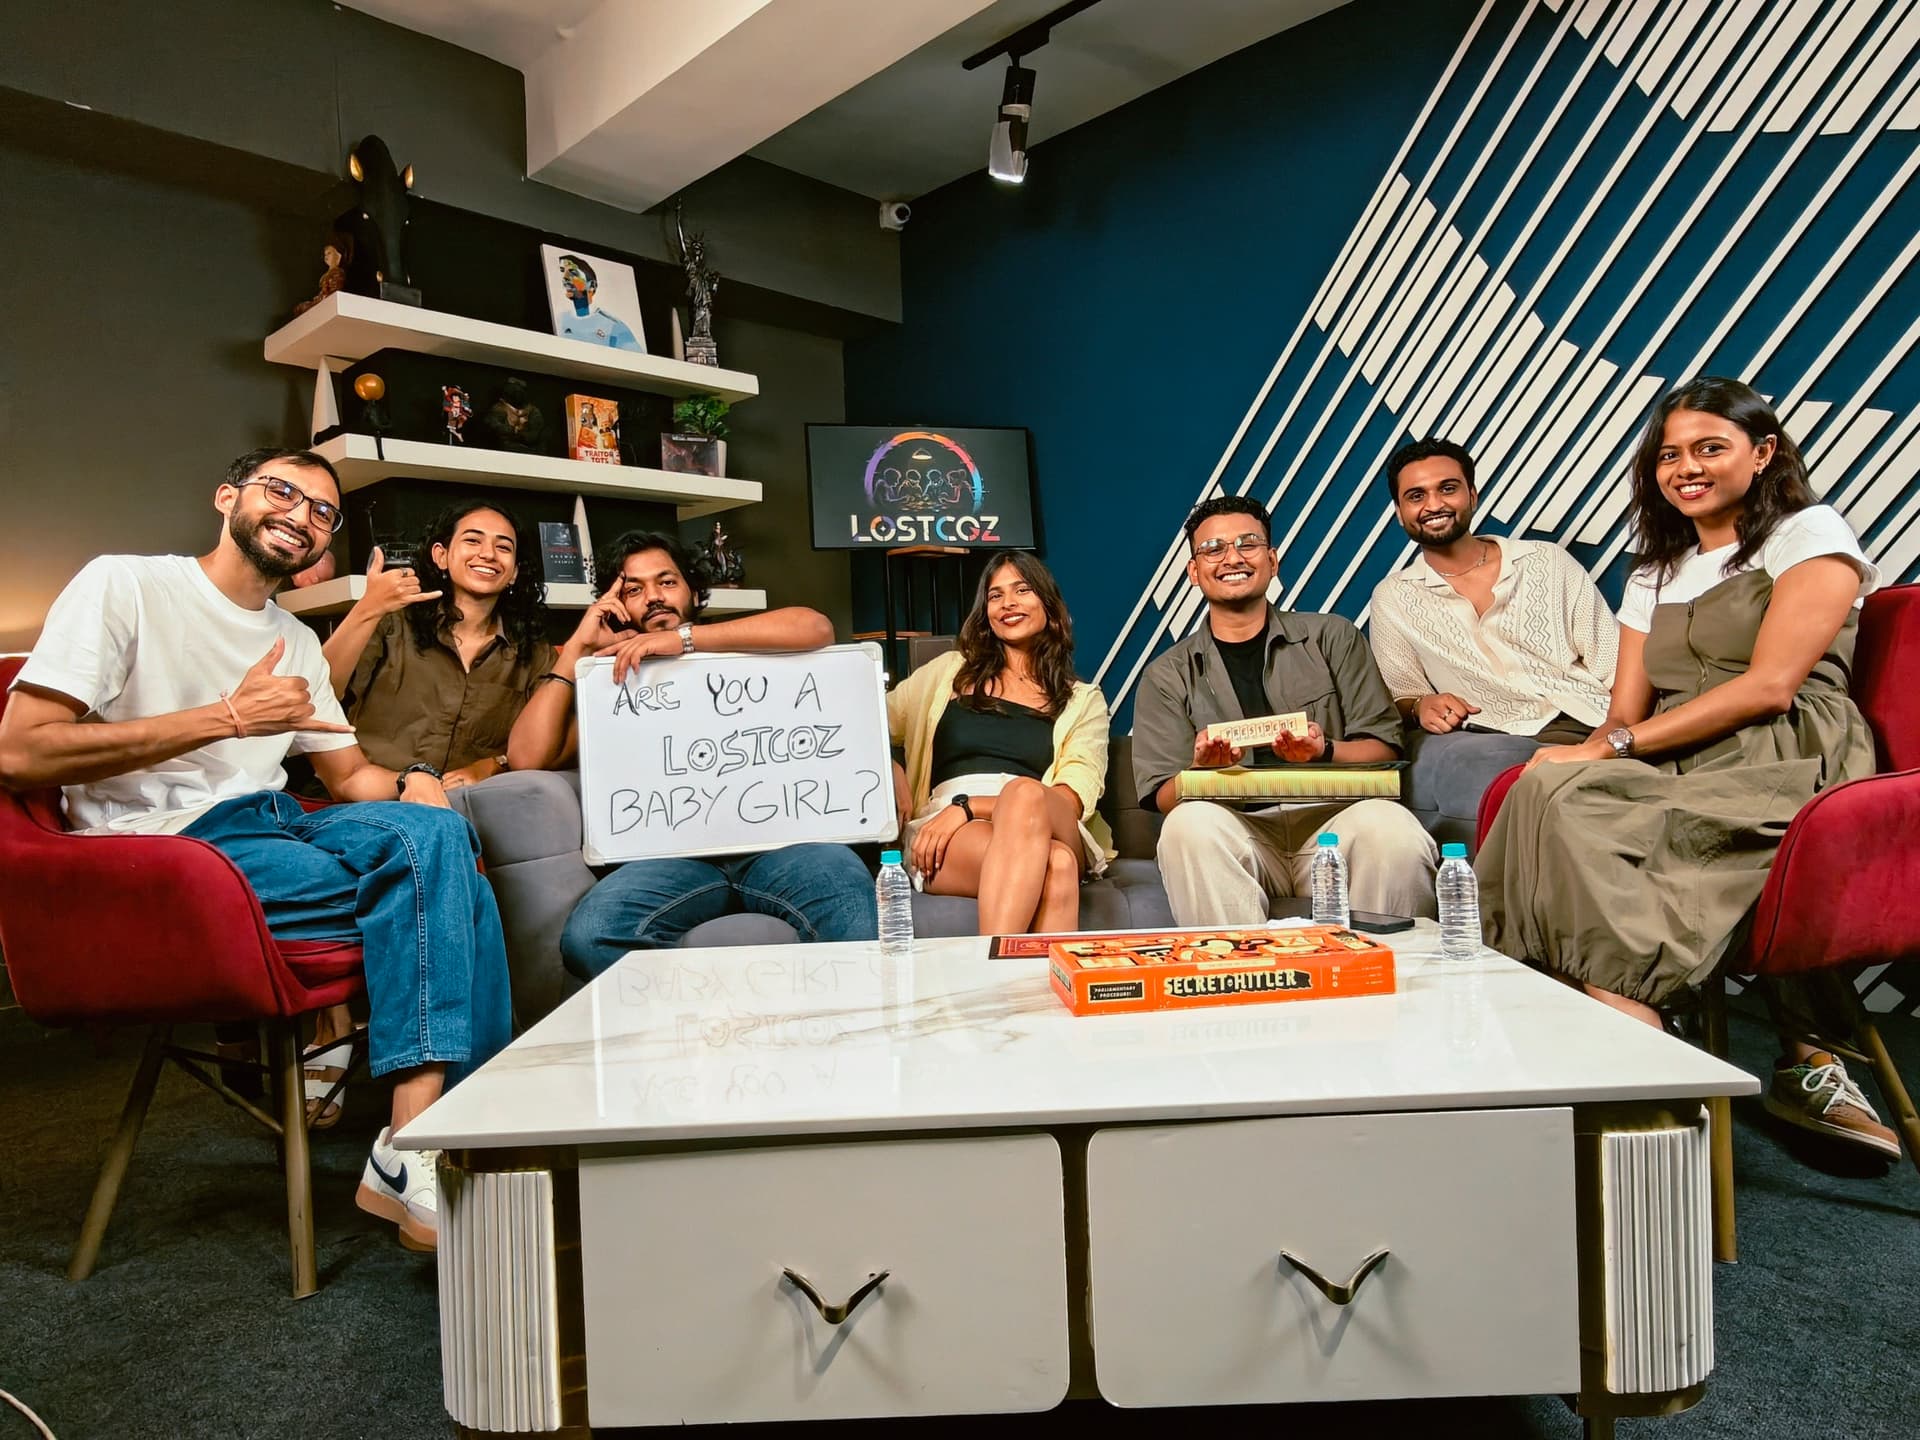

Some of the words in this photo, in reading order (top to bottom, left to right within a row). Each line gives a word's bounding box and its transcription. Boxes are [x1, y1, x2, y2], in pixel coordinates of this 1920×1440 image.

[851, 514, 1000, 542] LOSTCOZ
[613, 681, 681, 716] ARE
[706, 672, 768, 716] YOU
[795, 672, 822, 712] A
[663, 724, 846, 777] LOSTCOZ
[610, 785, 728, 835] BABY
[738, 769, 881, 825] GIRL?
[1163, 974, 1228, 996] SECRET
[1233, 968, 1298, 991] HITLER
